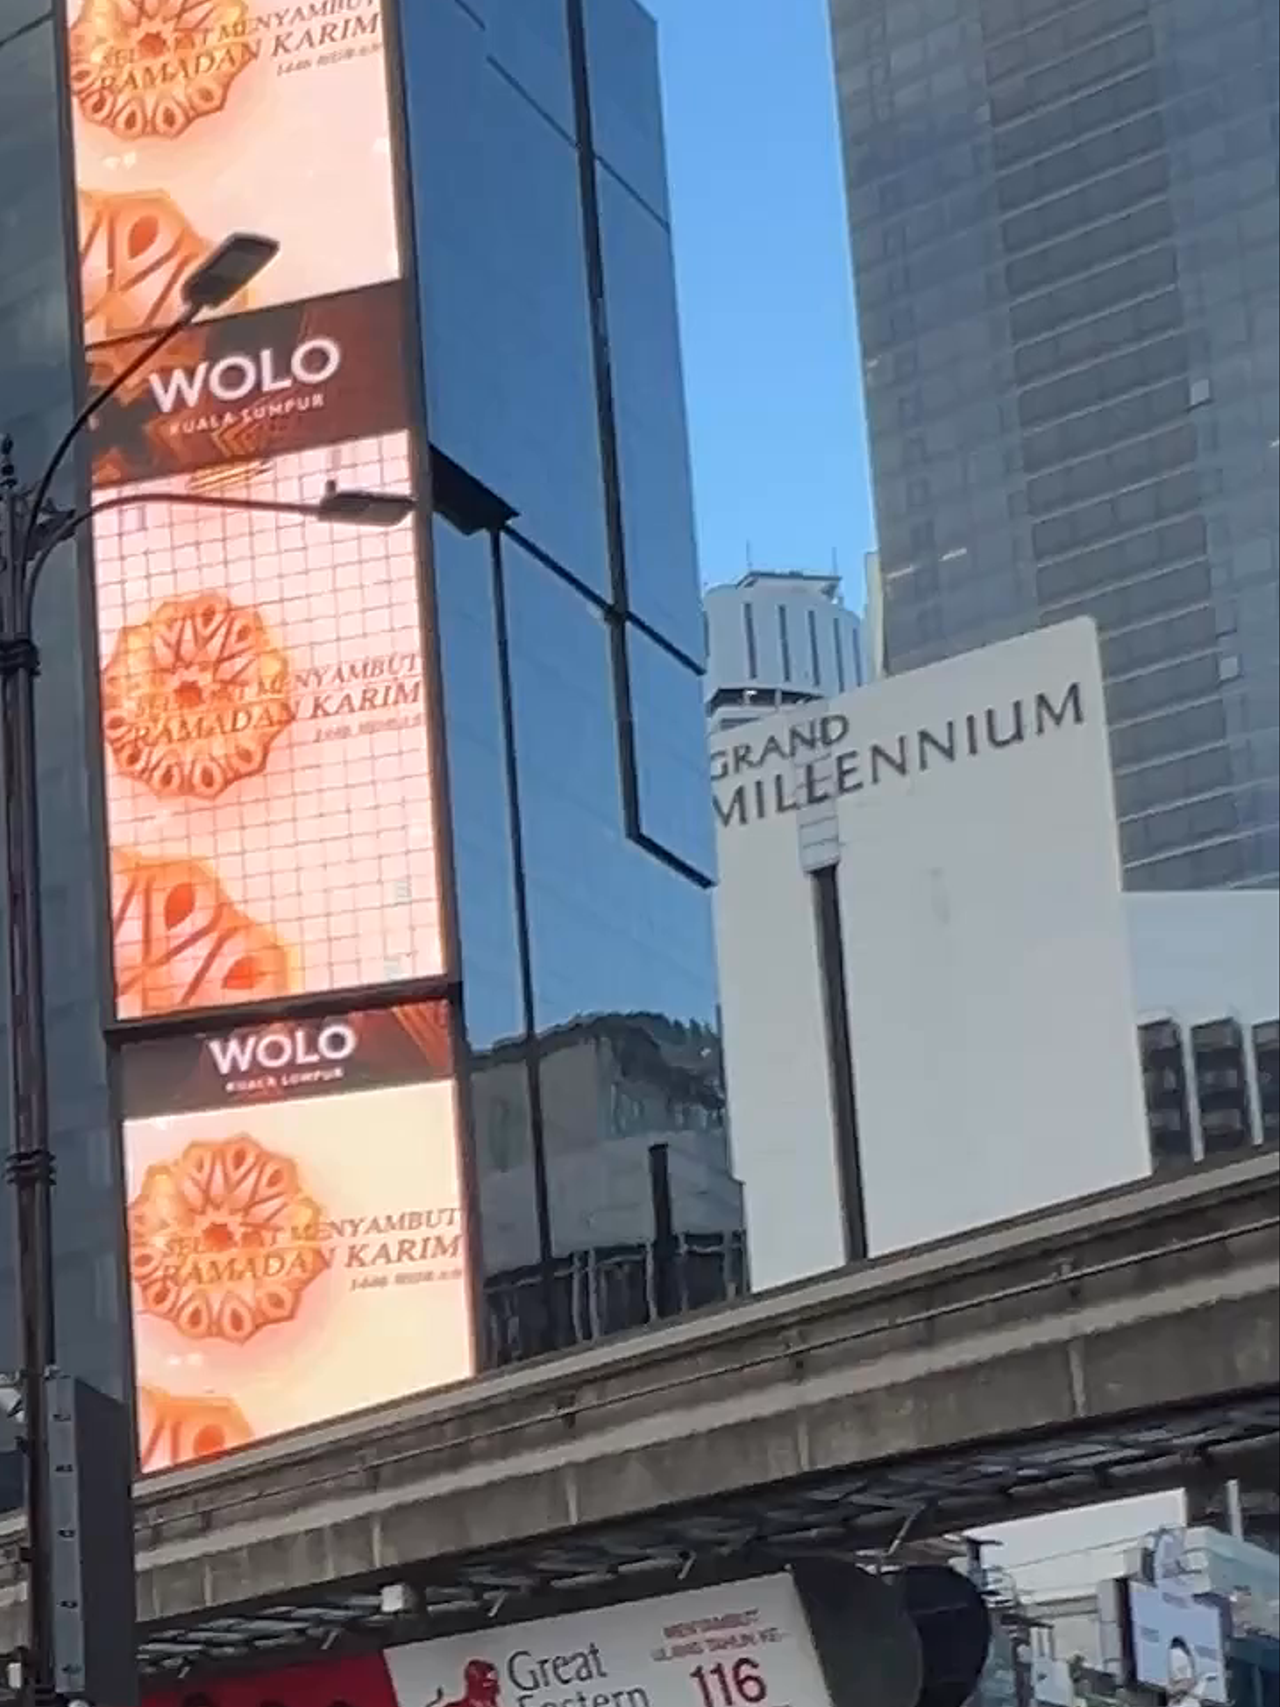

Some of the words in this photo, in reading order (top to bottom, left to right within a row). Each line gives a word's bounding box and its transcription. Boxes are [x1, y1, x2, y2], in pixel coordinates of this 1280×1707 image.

[100, 39, 262, 91] RAMADAN
[149, 338, 340, 414] WOLO
[169, 408, 237, 436] KUALA
[308, 680, 422, 720] KARIM
[710, 713, 850, 781] GRAND
[711, 681, 1085, 829] MILLENNIUM
[208, 1024, 357, 1076] WOLO
[344, 1233, 462, 1269] KARIM
[507, 1643, 608, 1691] Great
